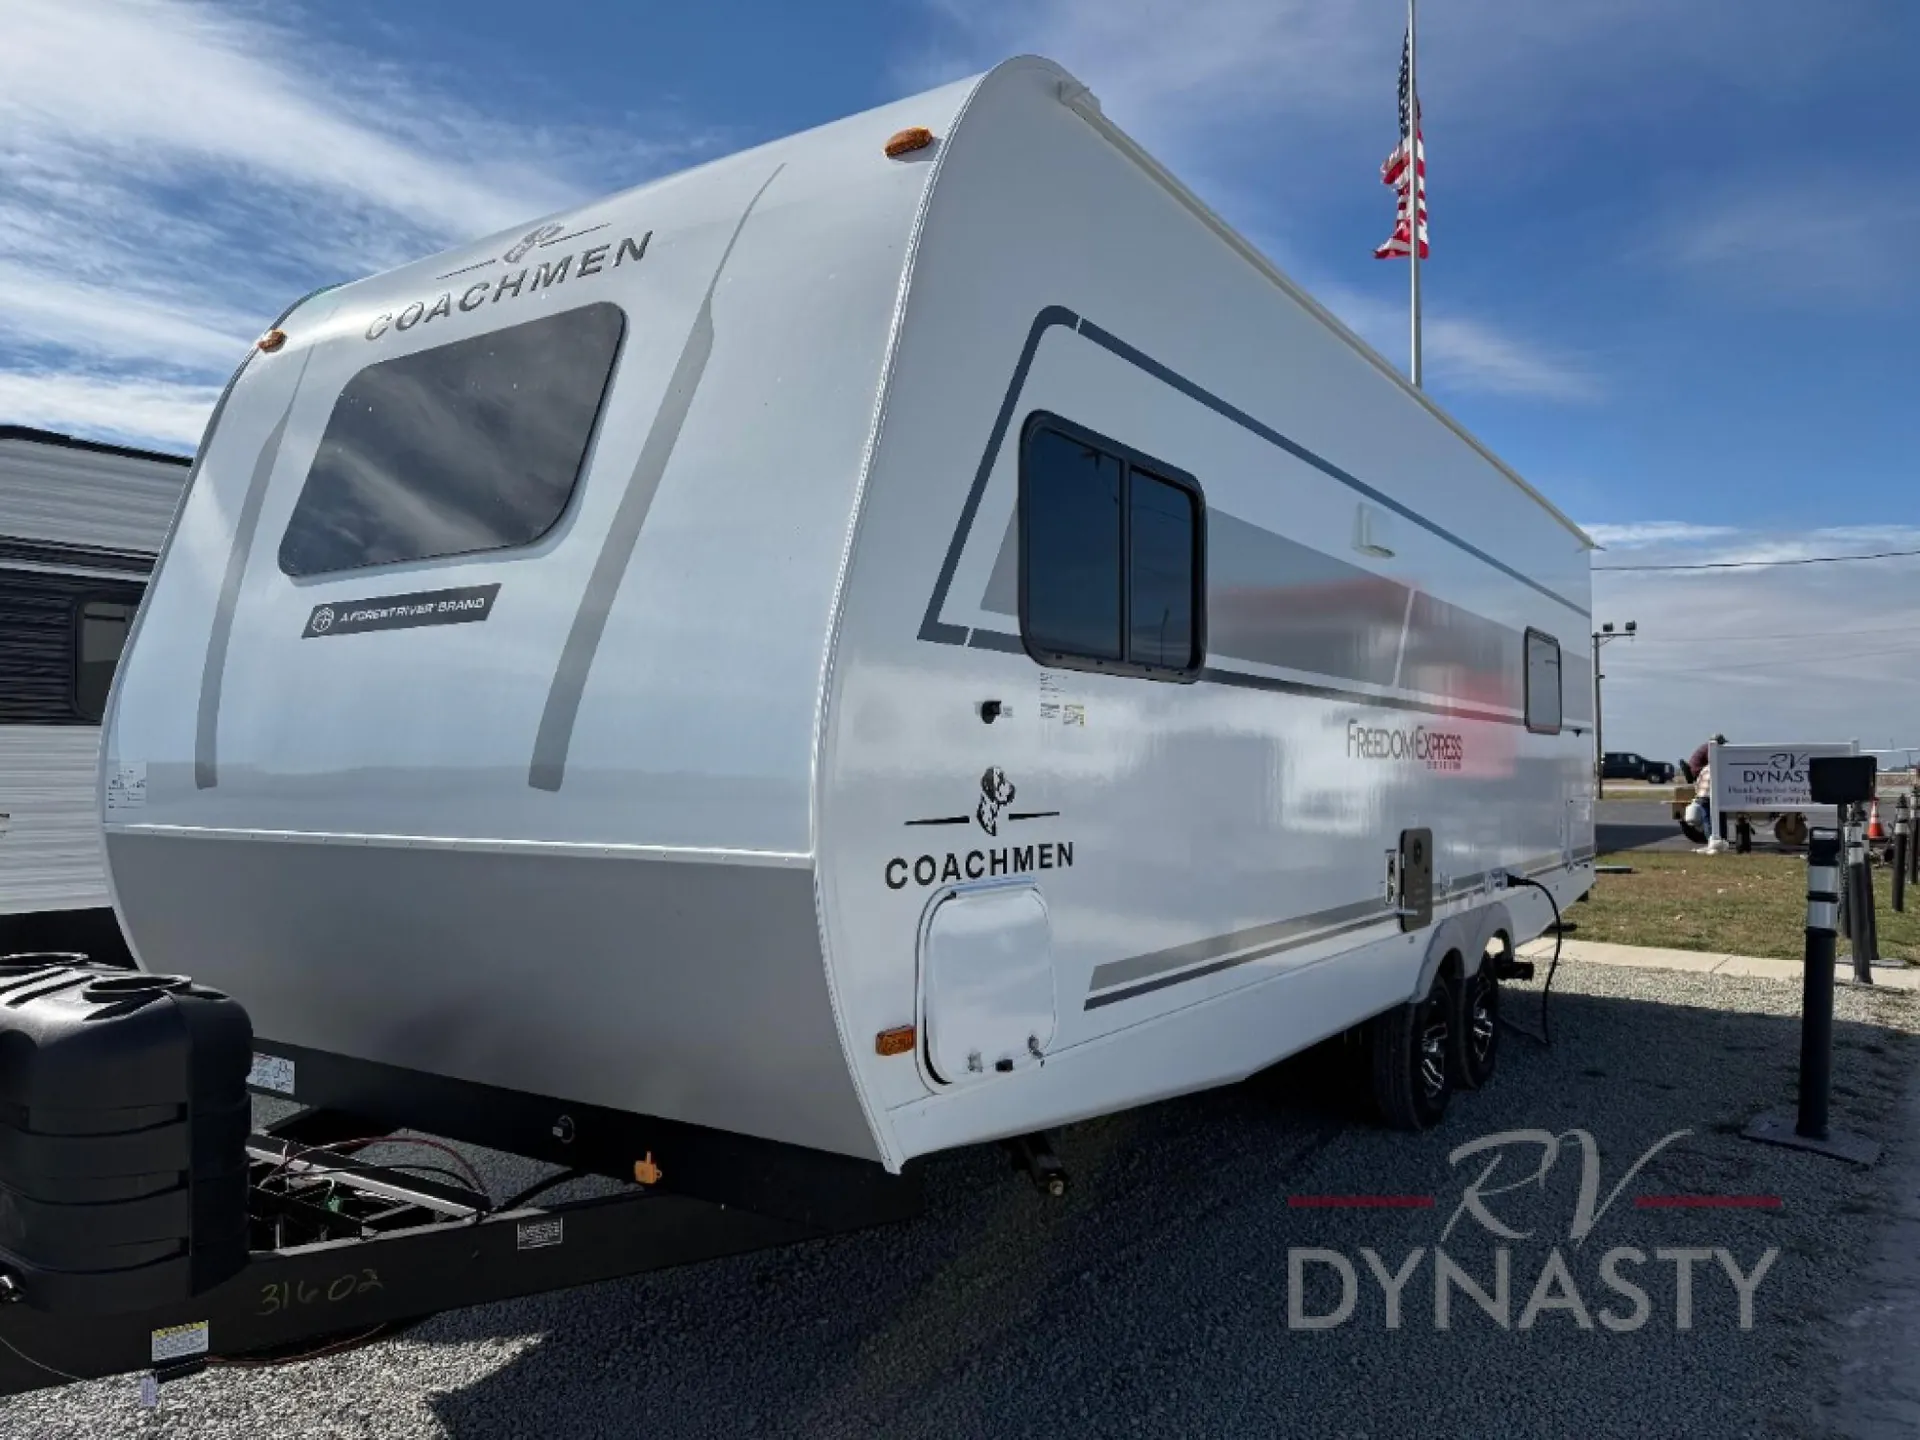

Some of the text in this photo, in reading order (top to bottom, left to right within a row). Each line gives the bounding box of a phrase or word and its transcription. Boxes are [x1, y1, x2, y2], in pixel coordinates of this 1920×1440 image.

[365, 230, 653, 341] COACHMEN
[437, 597, 485, 613] BRAND
[1743, 770, 1810, 783] DYNAST
[1769, 753, 1808, 770] RV
[885, 841, 1073, 890] COACHMEN
[255, 1268, 384, 1316] 31602
